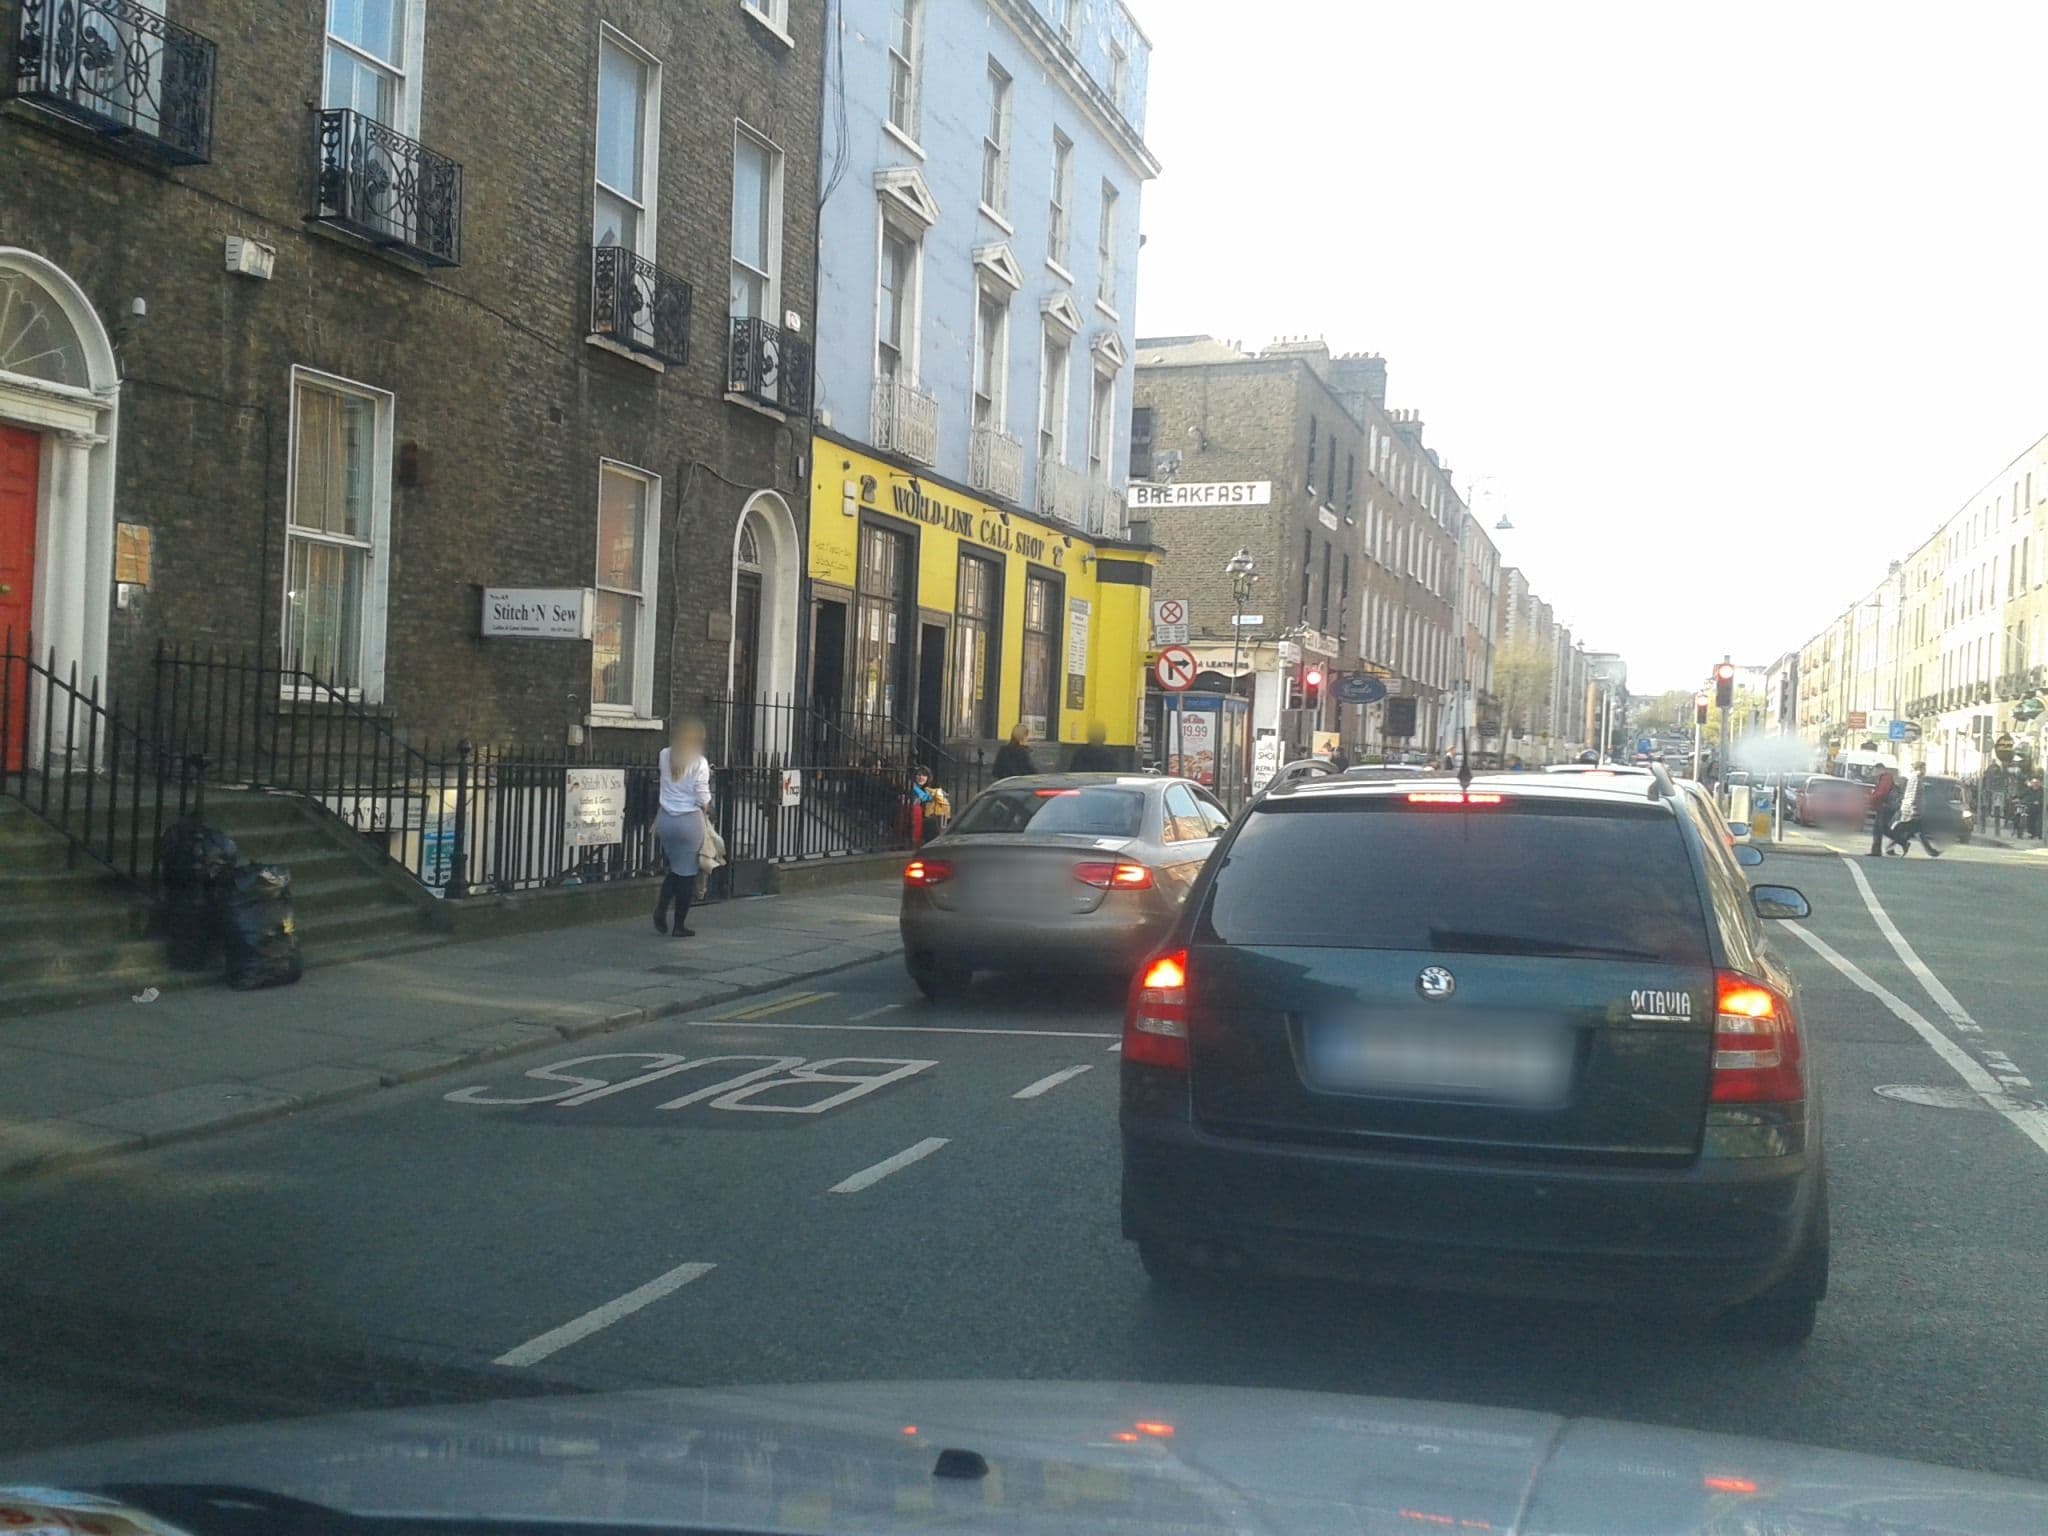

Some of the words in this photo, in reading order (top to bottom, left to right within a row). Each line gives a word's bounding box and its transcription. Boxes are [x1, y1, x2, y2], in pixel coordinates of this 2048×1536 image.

[1137, 485, 1257, 504] BREAKFAST
[980, 519, 1013, 551] CALL
[1015, 531, 1045, 561] SHOP
[493, 603, 529, 621] Stitch
[552, 604, 577, 622] Sew
[1206, 660, 1250, 670] LEATHRS
[1183, 724, 1208, 738] 19.99
[1630, 989, 1692, 1015] OCTAVIA
[443, 1053, 940, 1114] BUS
